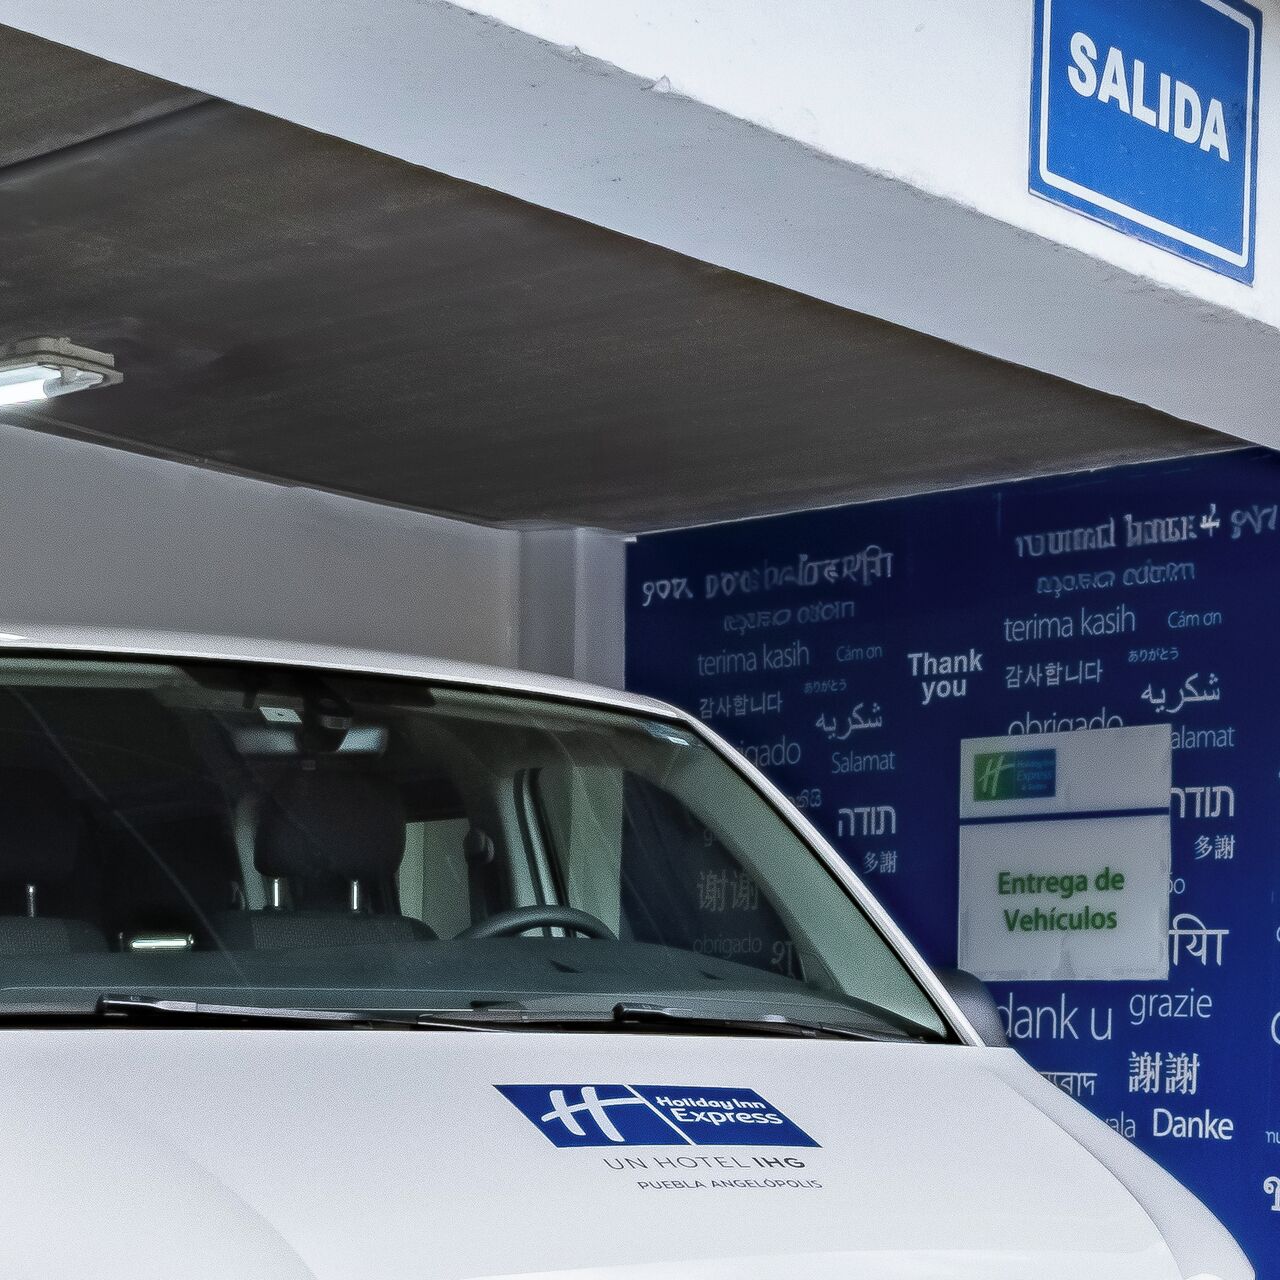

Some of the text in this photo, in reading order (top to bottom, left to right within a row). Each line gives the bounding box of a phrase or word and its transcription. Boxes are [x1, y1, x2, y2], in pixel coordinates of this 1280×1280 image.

[1067, 31, 1230, 162] SALIDA
[1004, 603, 1136, 642] terima kasih
[697, 640, 810, 677] terima kasih
[906, 648, 984, 678] Thank
[1128, 646, 1180, 663] ありがとう
[1005, 658, 1104, 689] 감사합니다
[699, 690, 784, 719] 감사합니다
[922, 680, 967, 705] you
[1171, 725, 1236, 750] alamat
[831, 751, 896, 775] Salamat
[838, 805, 897, 837] תודה
[1194, 835, 1236, 860] 多謝
[863, 851, 898, 874] 多謝
[997, 867, 1125, 898] Entrega de
[1004, 906, 1118, 932] Vehículos
[997, 992, 1112, 1041] dank u
[1129, 987, 1213, 1026] grazie
[1128, 1051, 1201, 1096] 謝謝
[655, 1096, 767, 1111] Holiday Inn
[670, 1108, 784, 1126] Express
[1153, 1108, 1234, 1141] Danke
[602, 1156, 806, 1170] UN HOTEL IHG
[637, 1178, 823, 1190] PUEBLA ANGELÓPOLIS
